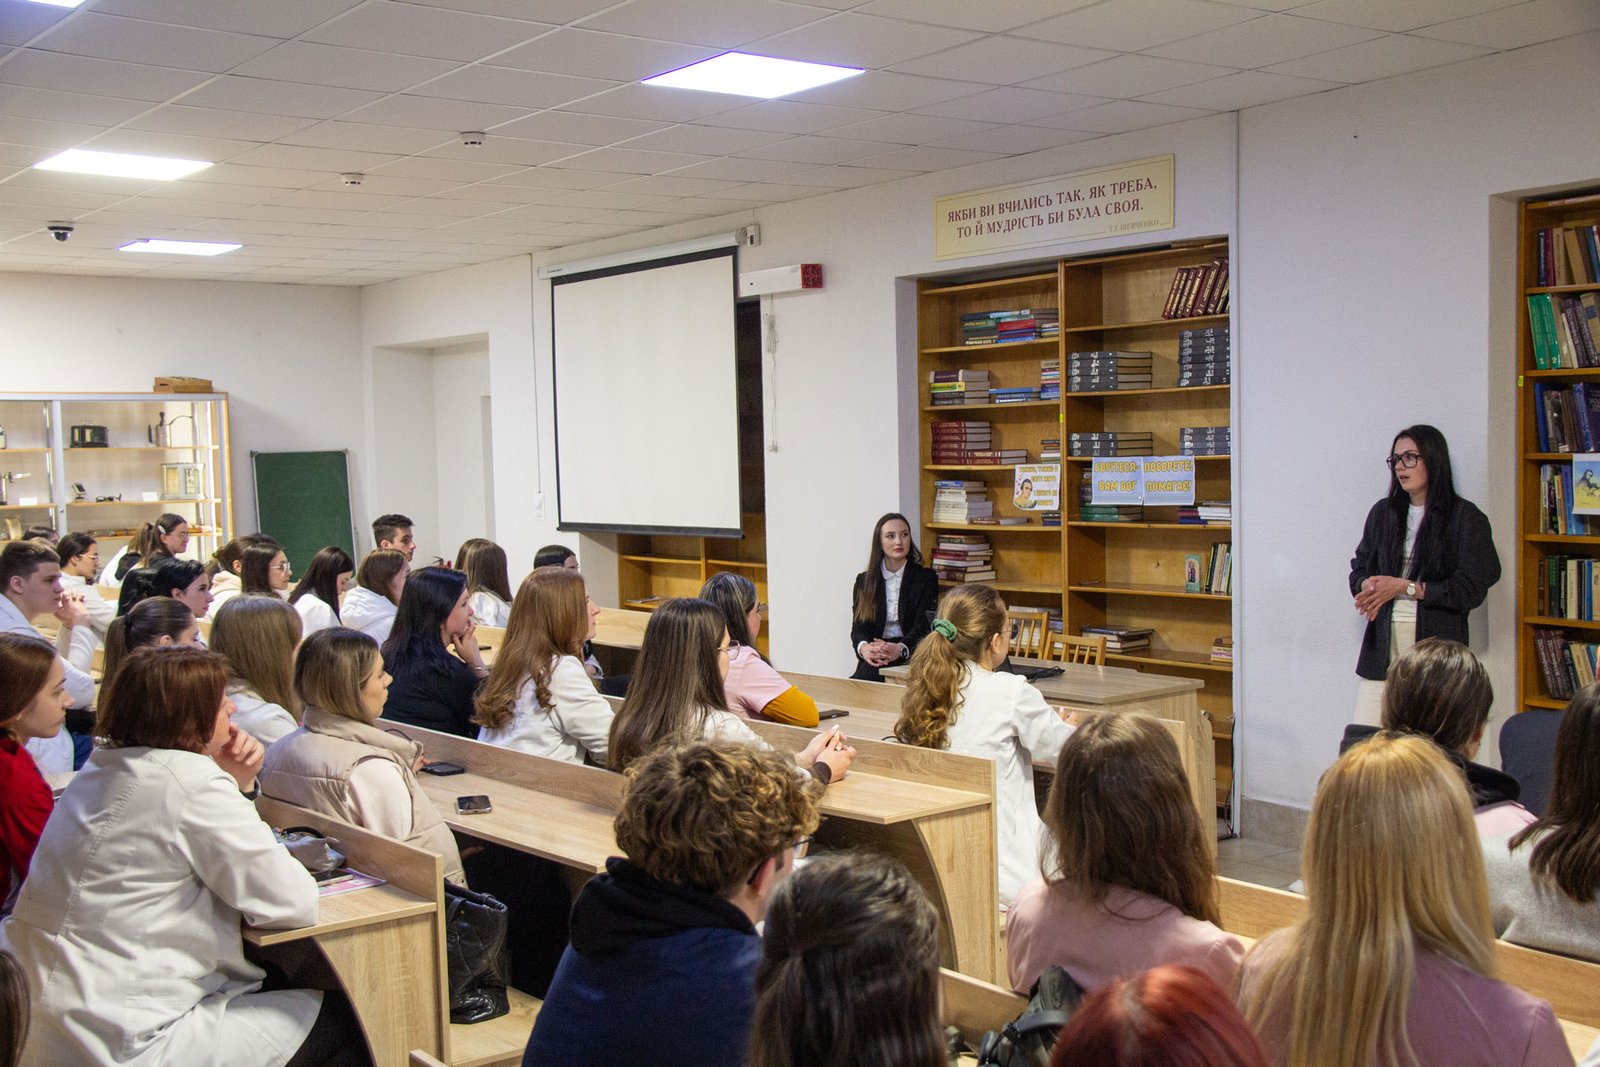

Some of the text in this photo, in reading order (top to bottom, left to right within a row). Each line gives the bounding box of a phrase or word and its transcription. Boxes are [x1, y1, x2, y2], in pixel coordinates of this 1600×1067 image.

[948, 208, 976, 222] ЯКБИ
[980, 204, 995, 217] ВИ
[998, 195, 1052, 213] ВЧИЛИСЬ
[1089, 185, 1106, 199] ЯК
[1110, 178, 1157, 195] ТРЕБА,
[957, 199, 1144, 239] ТО Й МУДРІСТЬ БИ БУЛА СВОЯ.
[1144, 460, 1193, 472] ПОБОРЕТЕ!
[1098, 480, 1118, 492] ВАМ
[1120, 480, 1137, 491] БОГ
